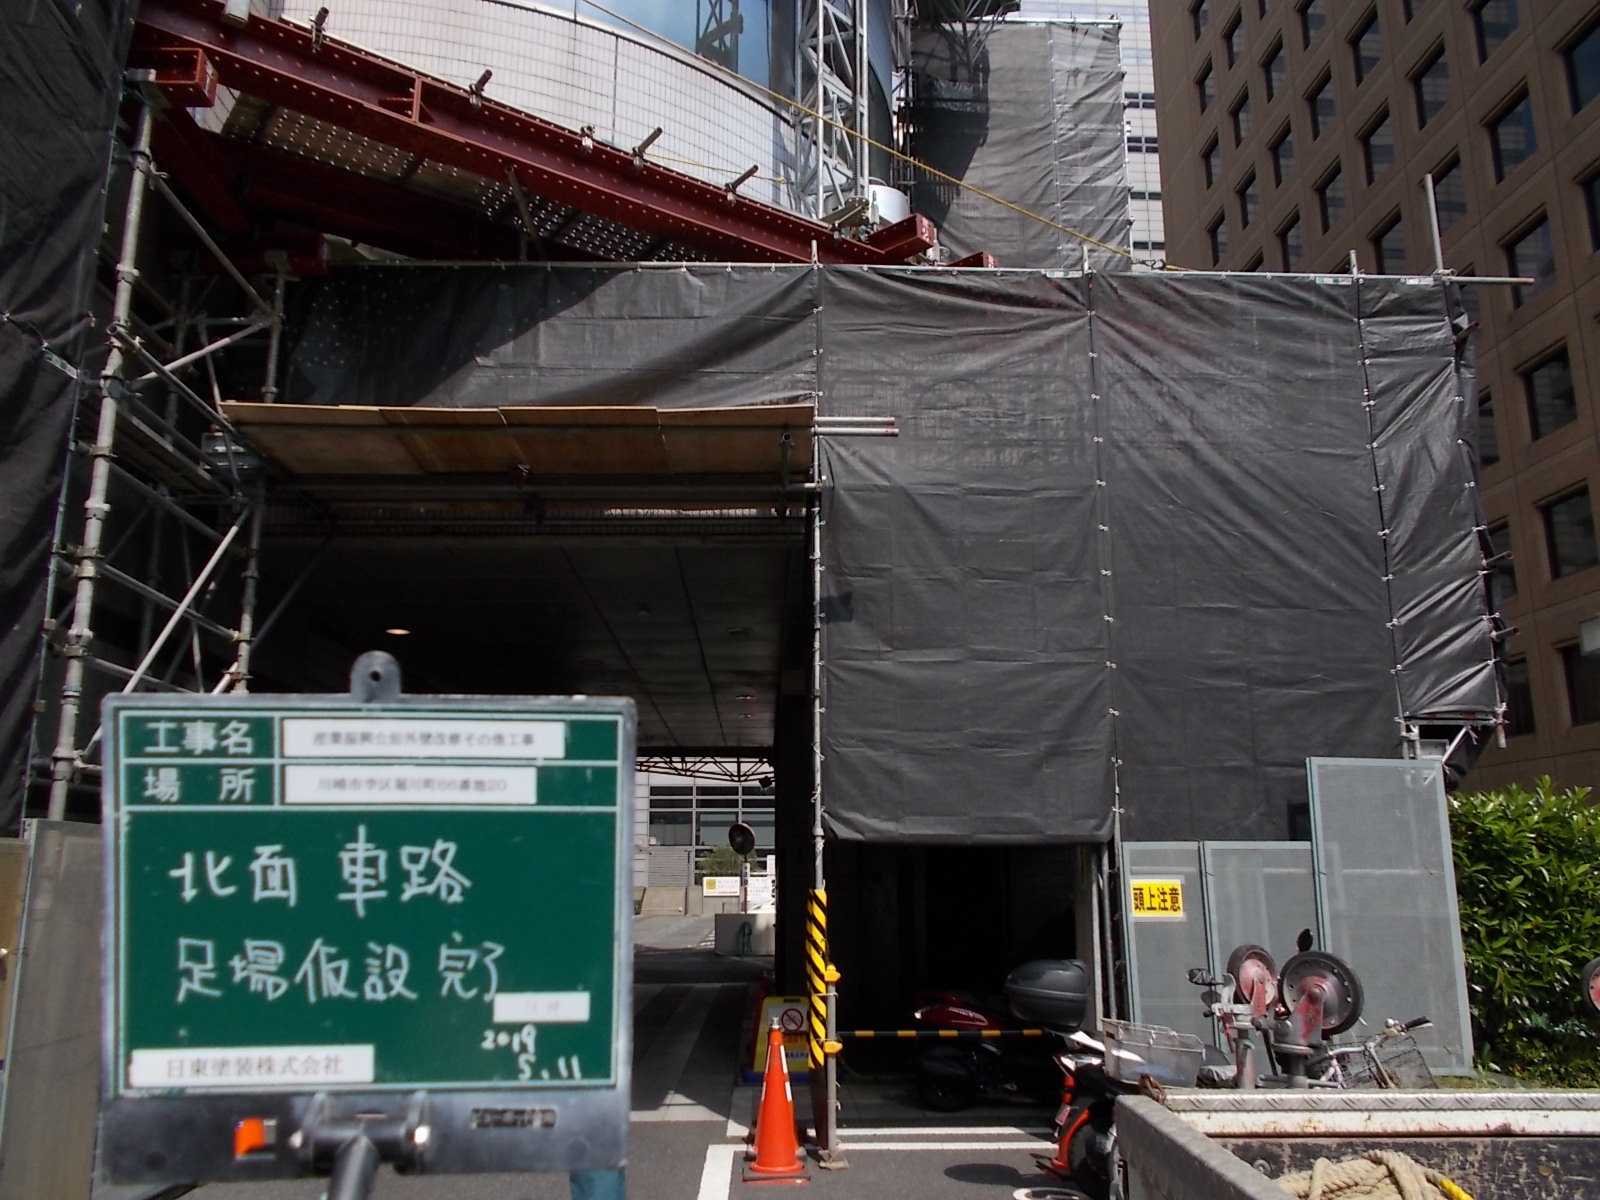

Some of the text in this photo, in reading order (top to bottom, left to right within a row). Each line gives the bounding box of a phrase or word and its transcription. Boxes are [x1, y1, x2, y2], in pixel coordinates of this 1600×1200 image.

[144, 721, 253, 755] 工事名
[169, 824, 472, 917] 北面 車路
[1133, 886, 1180, 911] 頭上注意
[480, 1024, 536, 1054] 2019
[167, 1054, 343, 1079] 日東塗装株式会社
